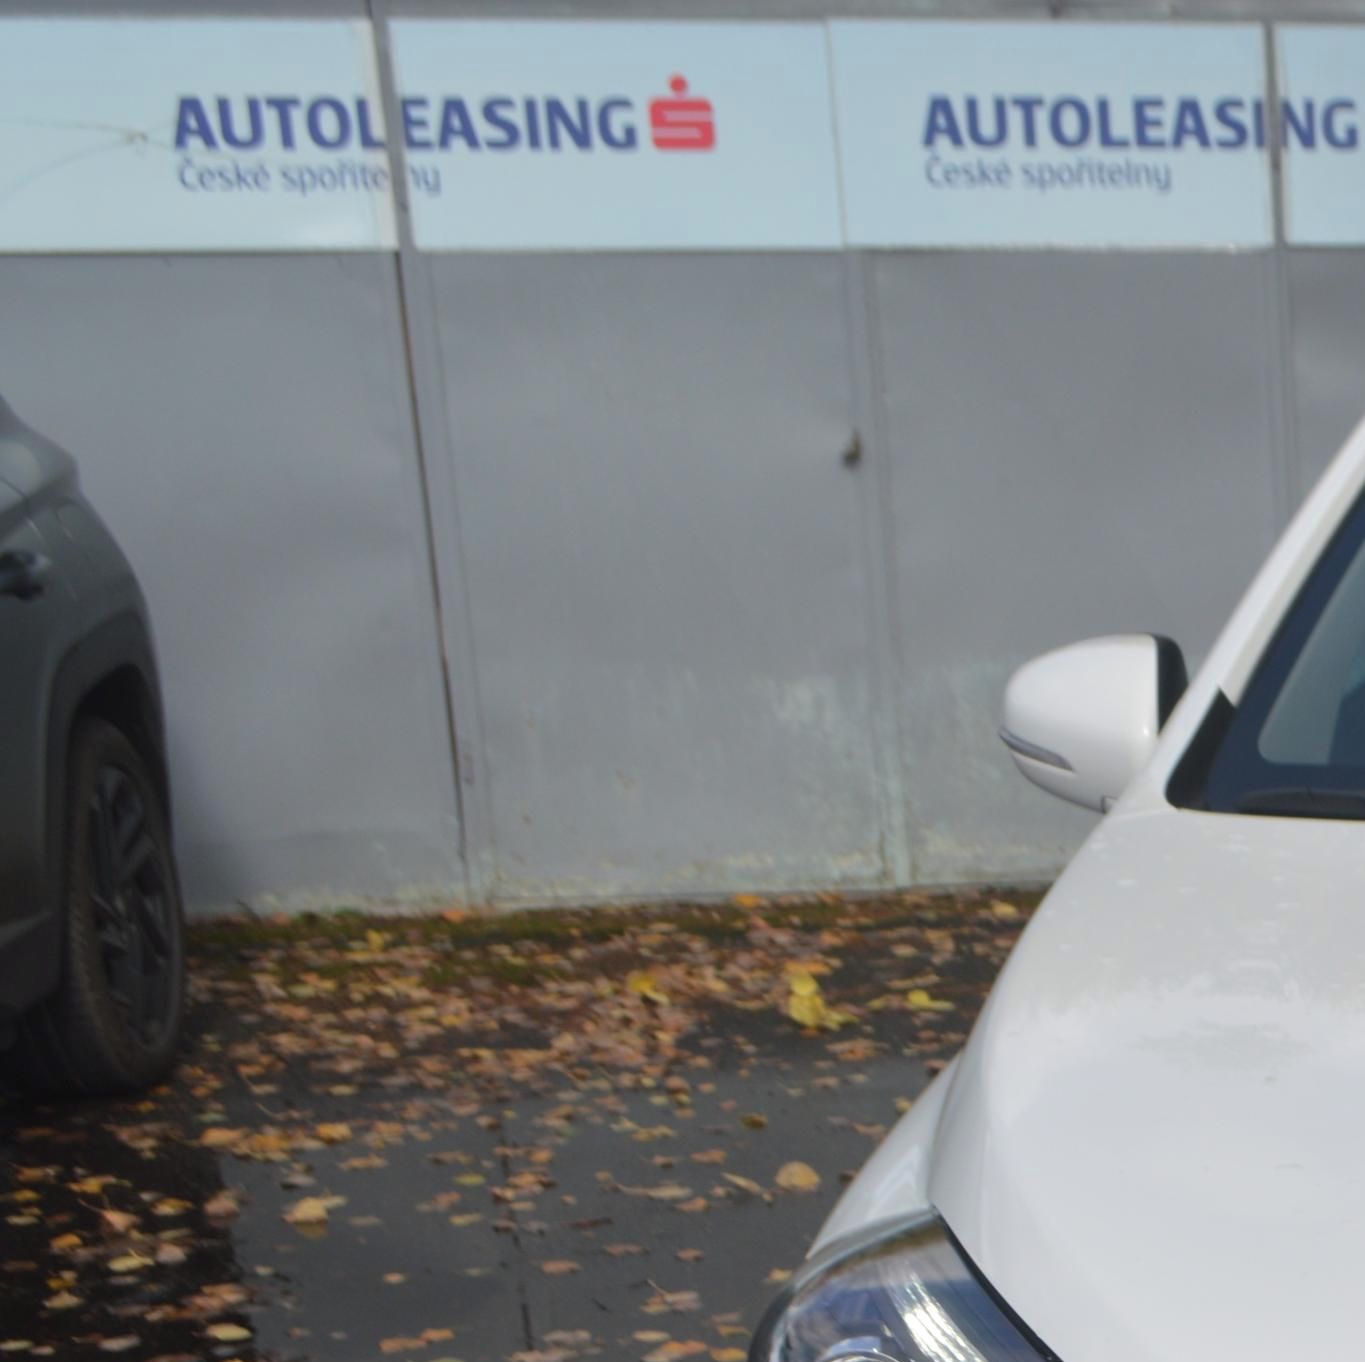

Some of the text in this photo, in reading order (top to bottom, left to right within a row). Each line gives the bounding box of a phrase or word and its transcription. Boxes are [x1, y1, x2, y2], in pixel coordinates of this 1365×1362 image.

[174, 96, 639, 151] AUTOLEASING
[922, 95, 1358, 150] AUTOLEASING
[179, 157, 441, 196] České spořiteny
[925, 155, 1172, 194] České spořitelny
